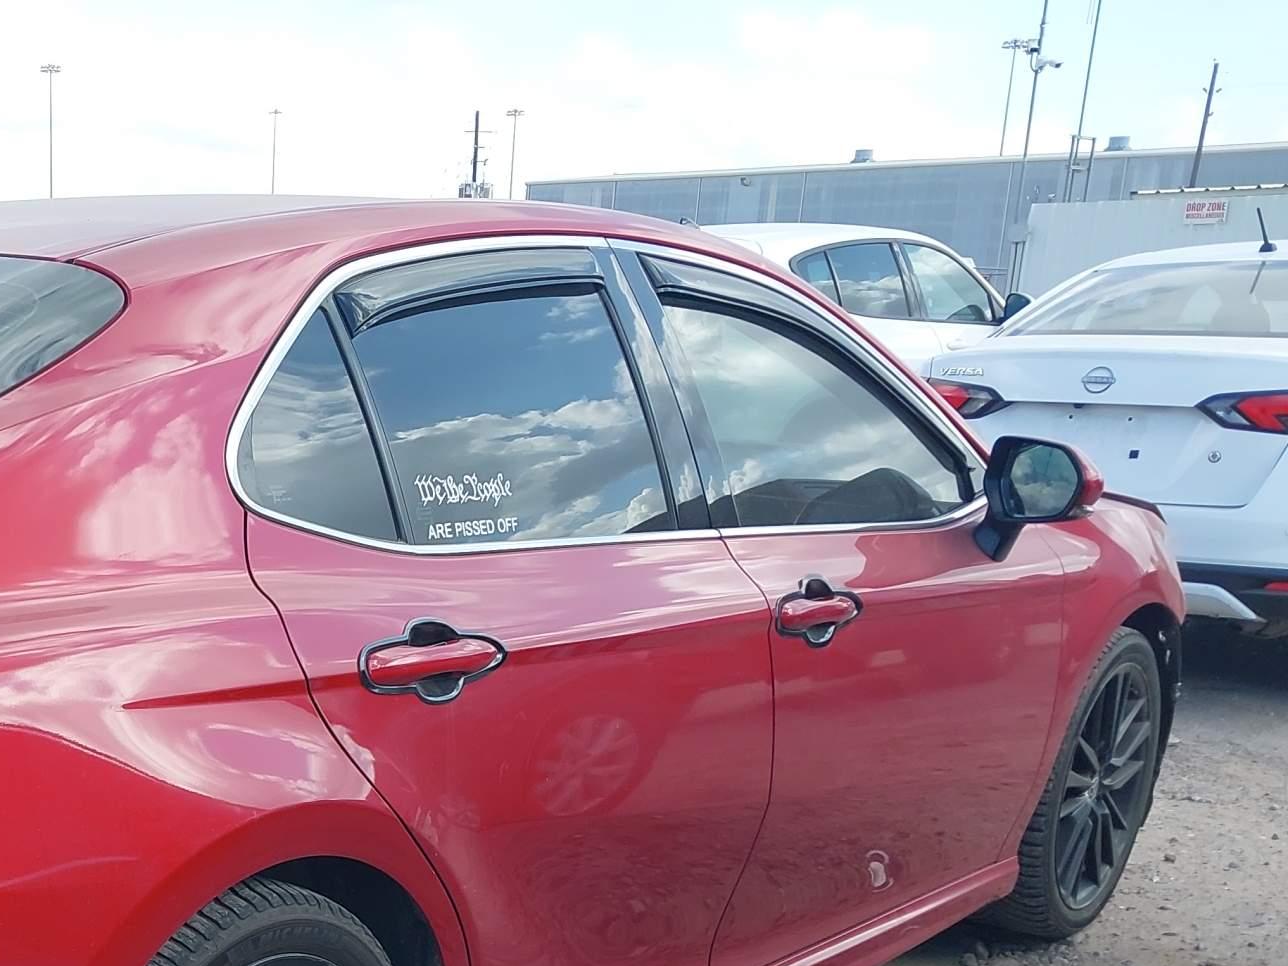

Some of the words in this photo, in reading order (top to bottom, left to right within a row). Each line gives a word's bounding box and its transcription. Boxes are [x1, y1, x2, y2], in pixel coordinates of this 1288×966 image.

[1186, 202, 1206, 212] DROP
[1207, 202, 1226, 211] ZONE
[940, 367, 984, 377] VERSA
[414, 475, 446, 506] We
[463, 472, 512, 507] People
[428, 523, 453, 540] ARE
[454, 519, 495, 537] PISSED
[497, 517, 518, 533] OFF
